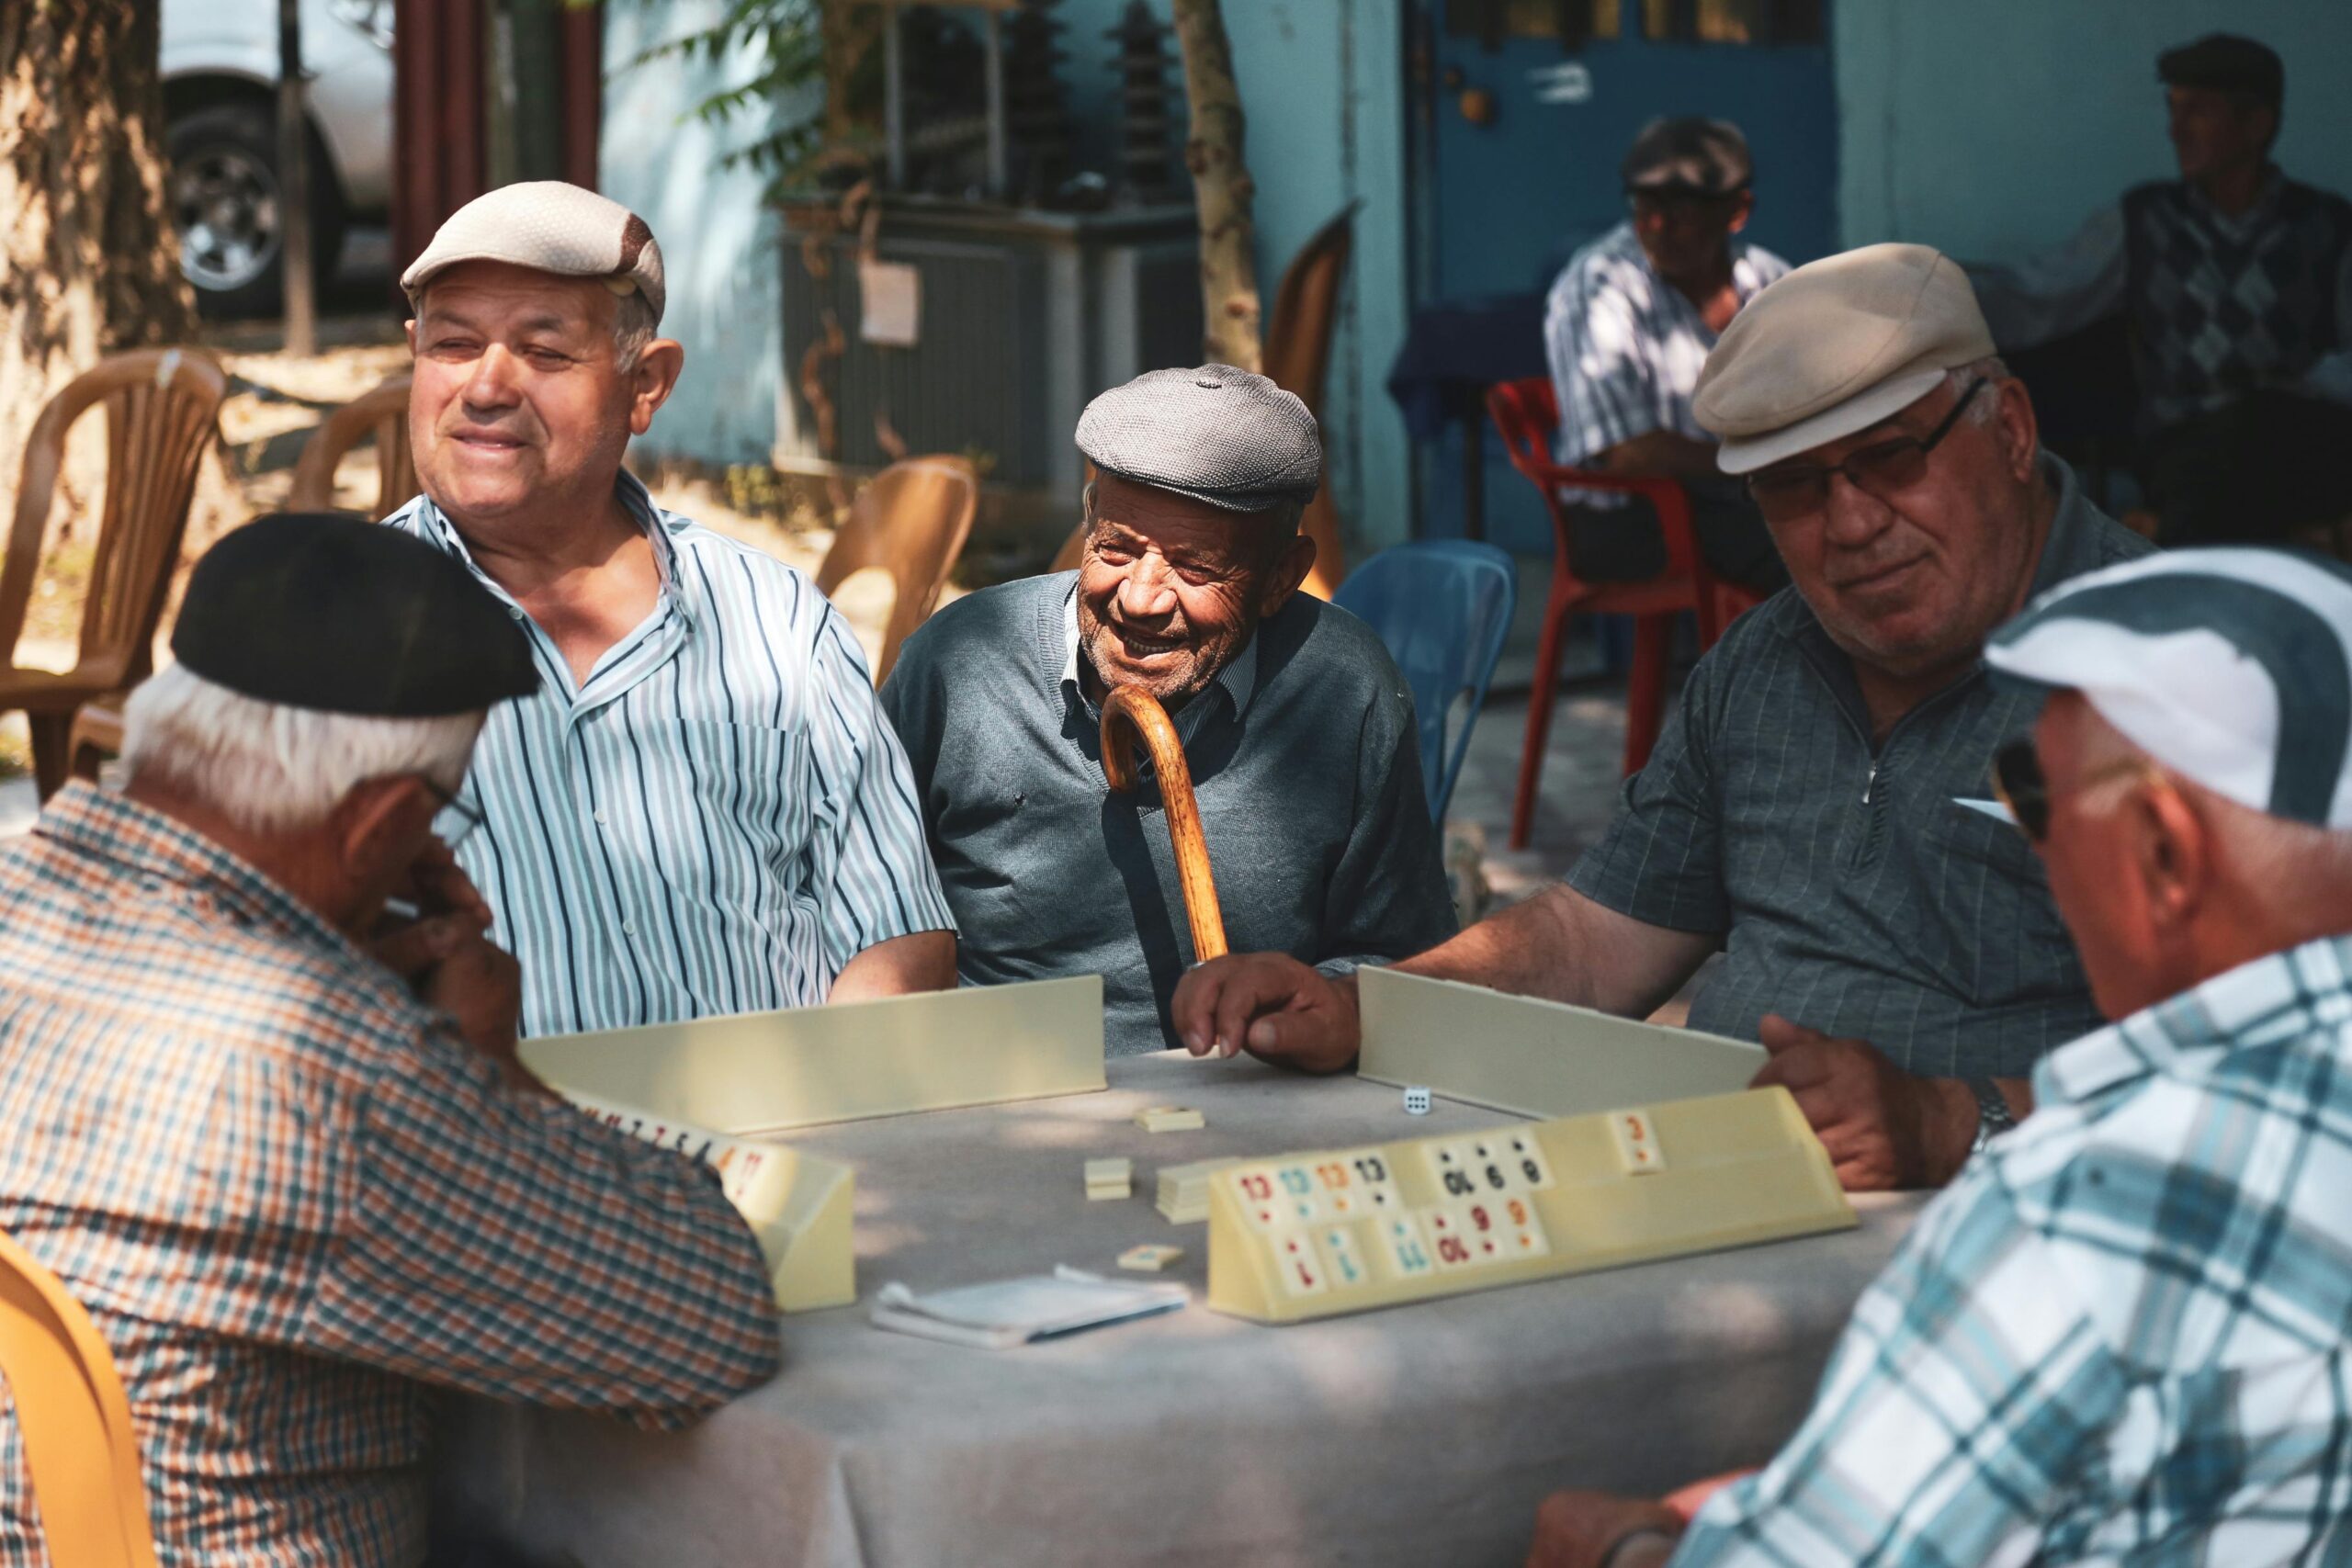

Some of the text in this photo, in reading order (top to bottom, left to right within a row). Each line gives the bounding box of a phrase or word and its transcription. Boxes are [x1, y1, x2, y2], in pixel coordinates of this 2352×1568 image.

[1625, 1115, 1644, 1141] 3
[1443, 1170, 1475, 1196] 10
[1438, 1235, 1469, 1264] 10
